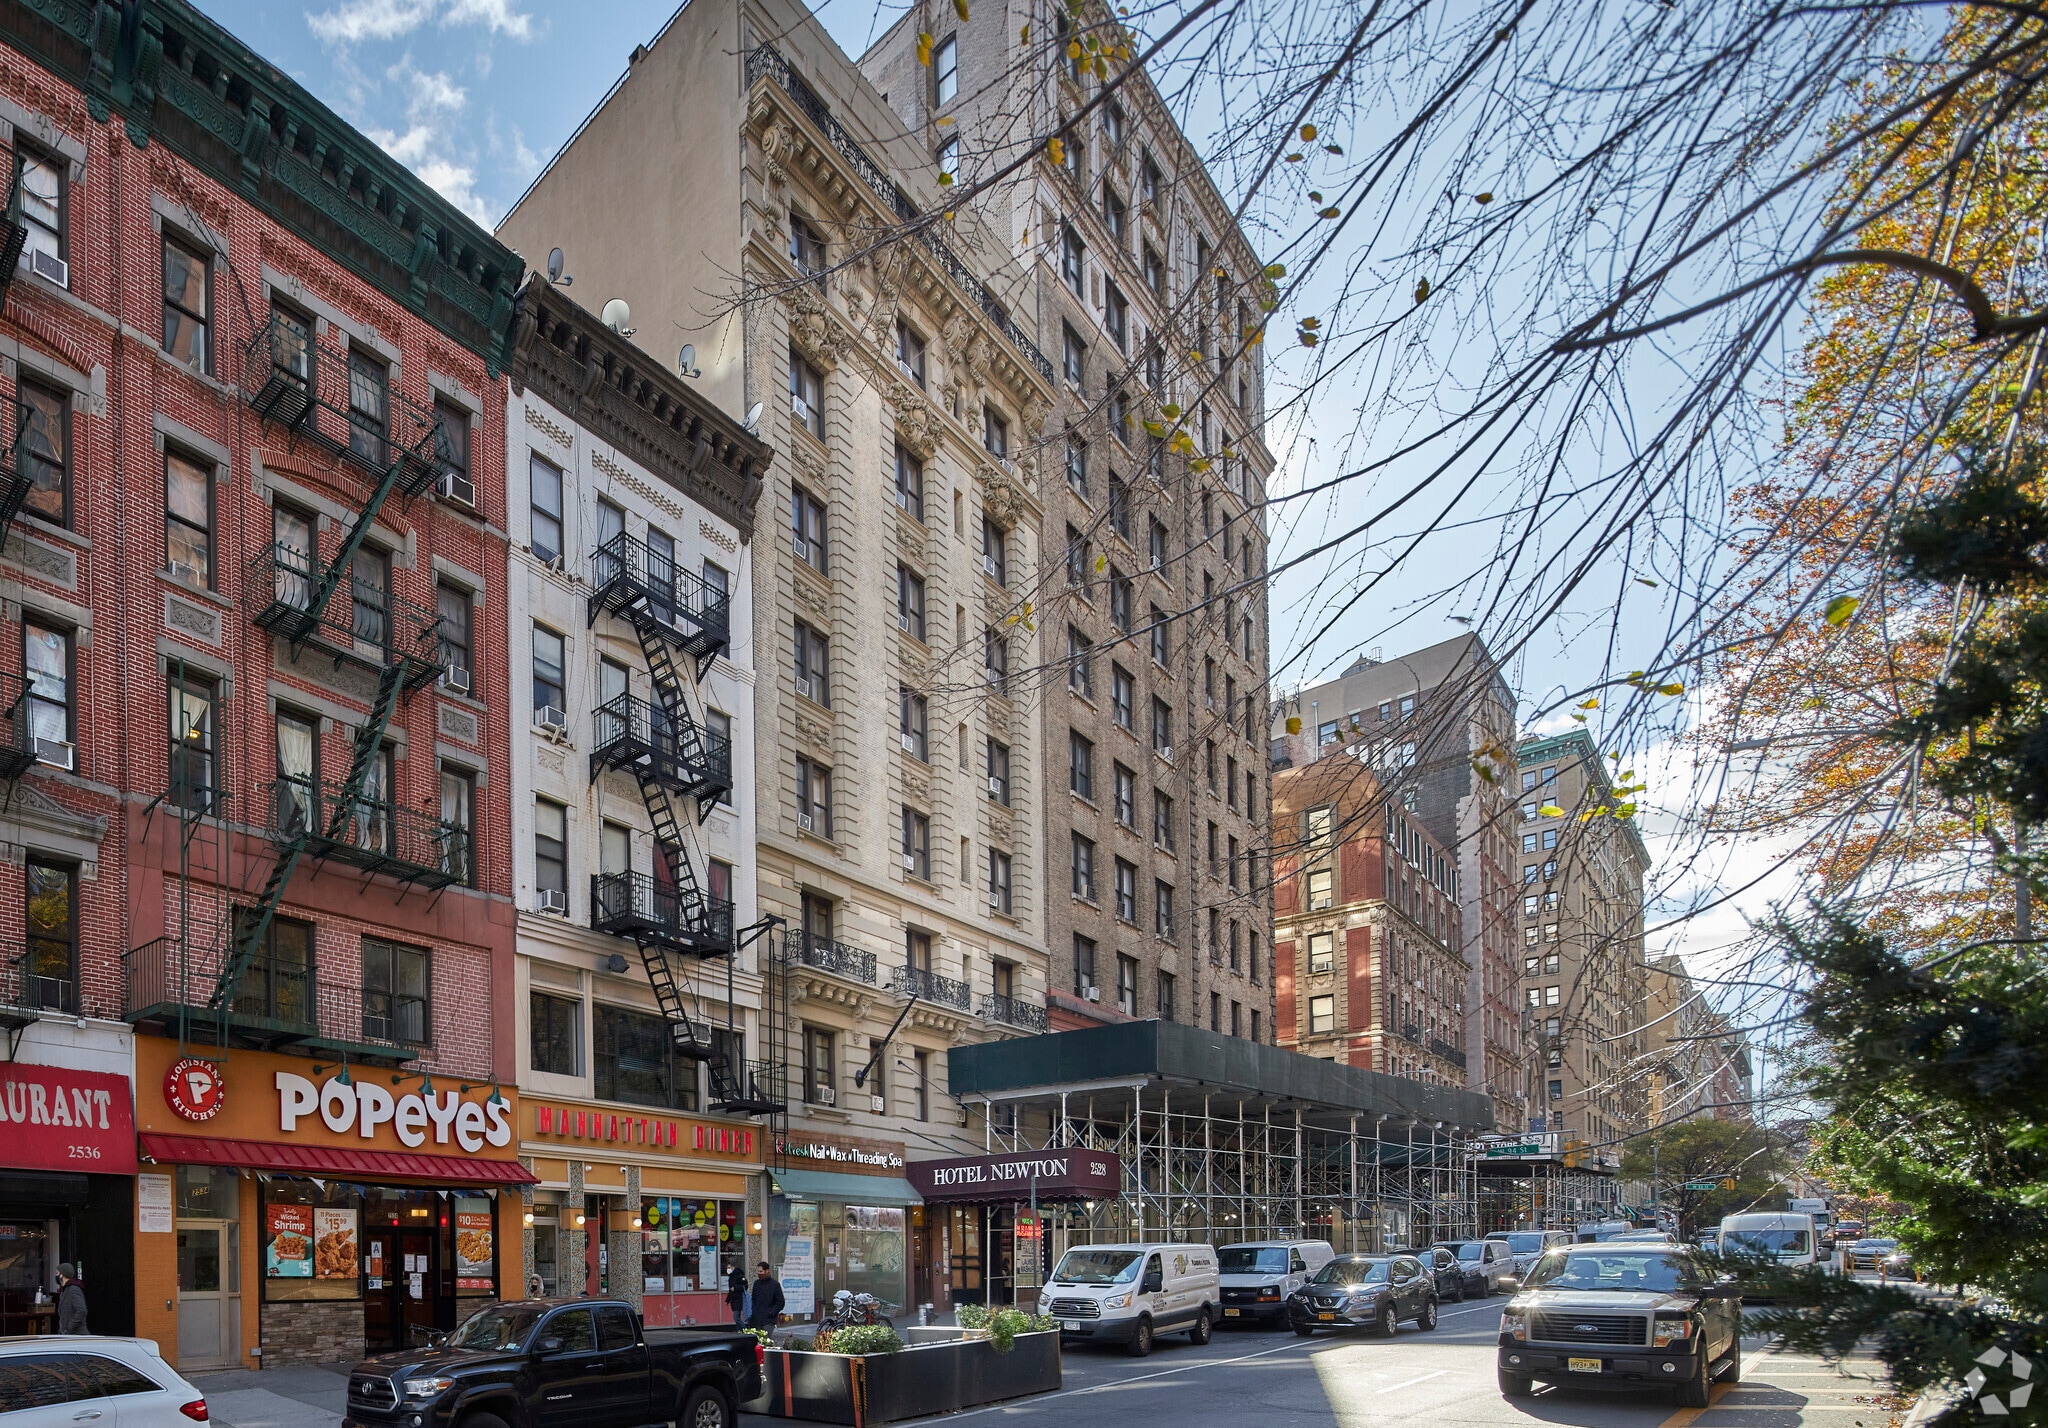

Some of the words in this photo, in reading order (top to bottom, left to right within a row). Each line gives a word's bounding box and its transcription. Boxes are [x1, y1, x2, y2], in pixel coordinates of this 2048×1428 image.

[172, 1096, 221, 1121] KITCHEN
[536, 1106, 677, 1147] MANHATTAN
[692, 1125, 753, 1155] DINER
[67, 1145, 101, 1160] 2536
[809, 1143, 826, 1160] Nail
[829, 1146, 847, 1162] Wax
[851, 1148, 887, 1169] Threading
[888, 1152, 903, 1168] Spa
[1520, 1146, 1528, 1154] St
[933, 1165, 987, 1186] HOTEL
[990, 1158, 1068, 1182] NEWTON
[1090, 1161, 1107, 1177] 2528
[274, 1220, 306, 1232] Shrimp
[458, 1215, 471, 1226] $10
[373, 1243, 380, 1254] A
[600, 1252, 606, 1261] A
[298, 1261, 309, 1274] $5
[546, 1393, 573, 1401] TACOMA
